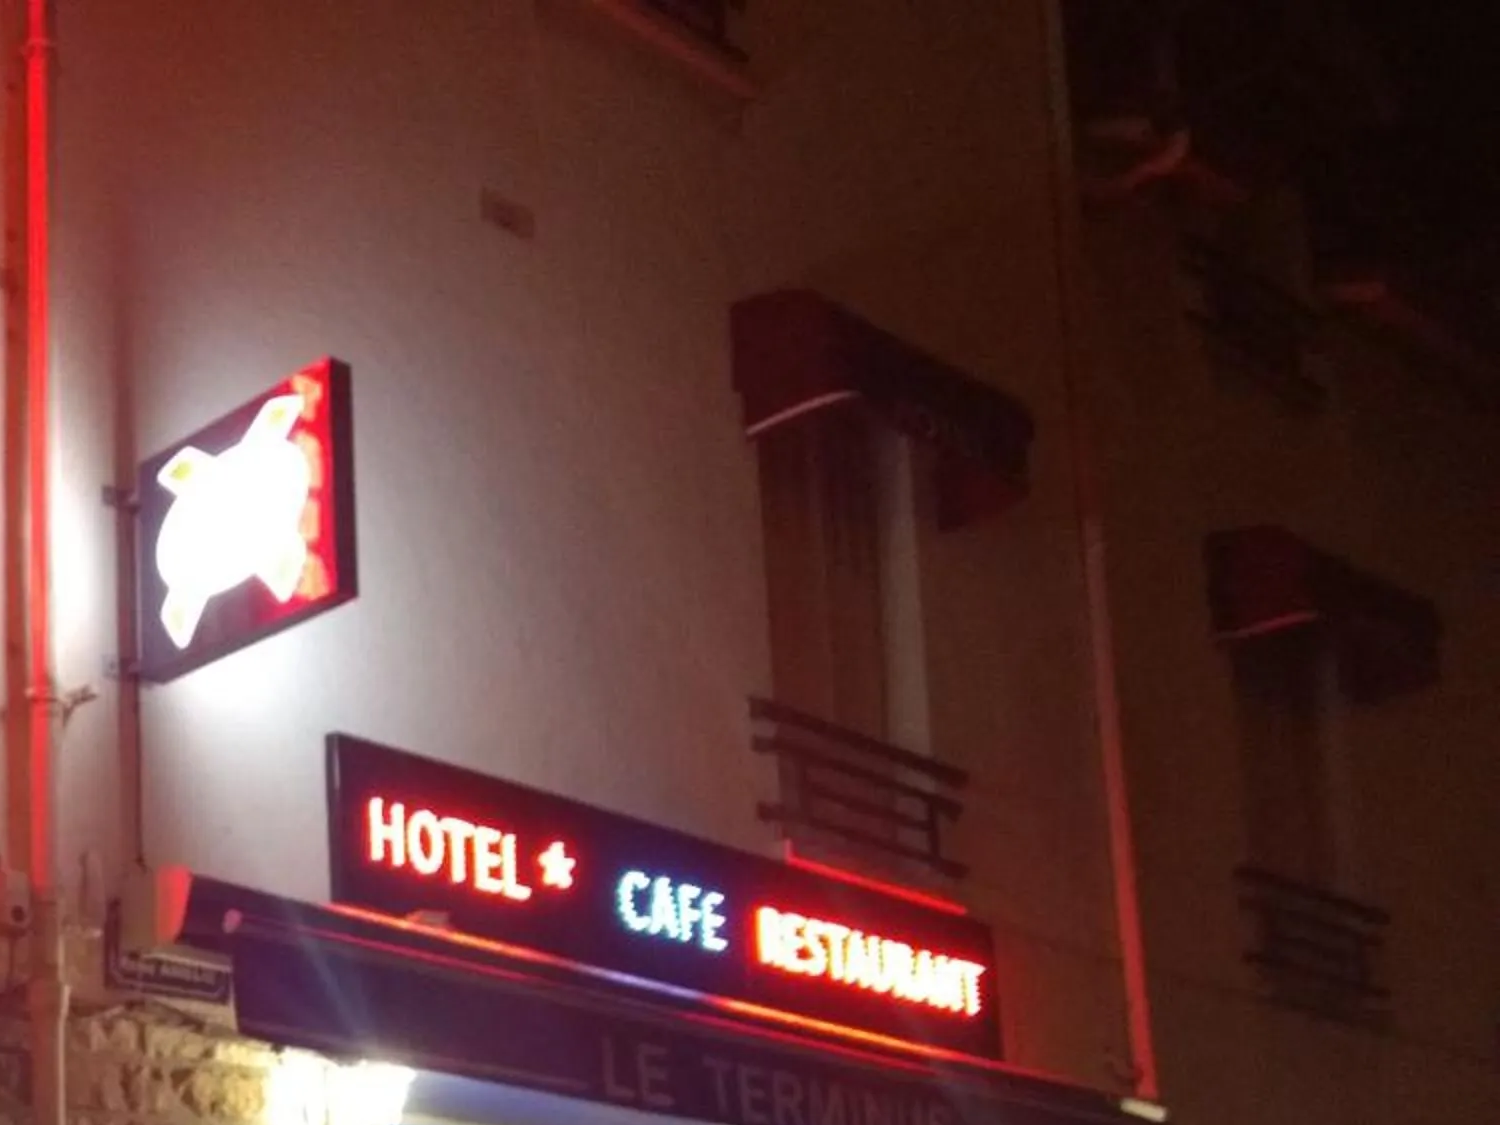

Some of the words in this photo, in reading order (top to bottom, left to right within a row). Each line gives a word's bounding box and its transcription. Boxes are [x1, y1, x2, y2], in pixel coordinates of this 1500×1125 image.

[366, 796, 533, 901] HOTEL
[615, 870, 731, 953] CAFE
[752, 906, 988, 1018] RESTAURANT
[602, 1034, 675, 1105] LE
